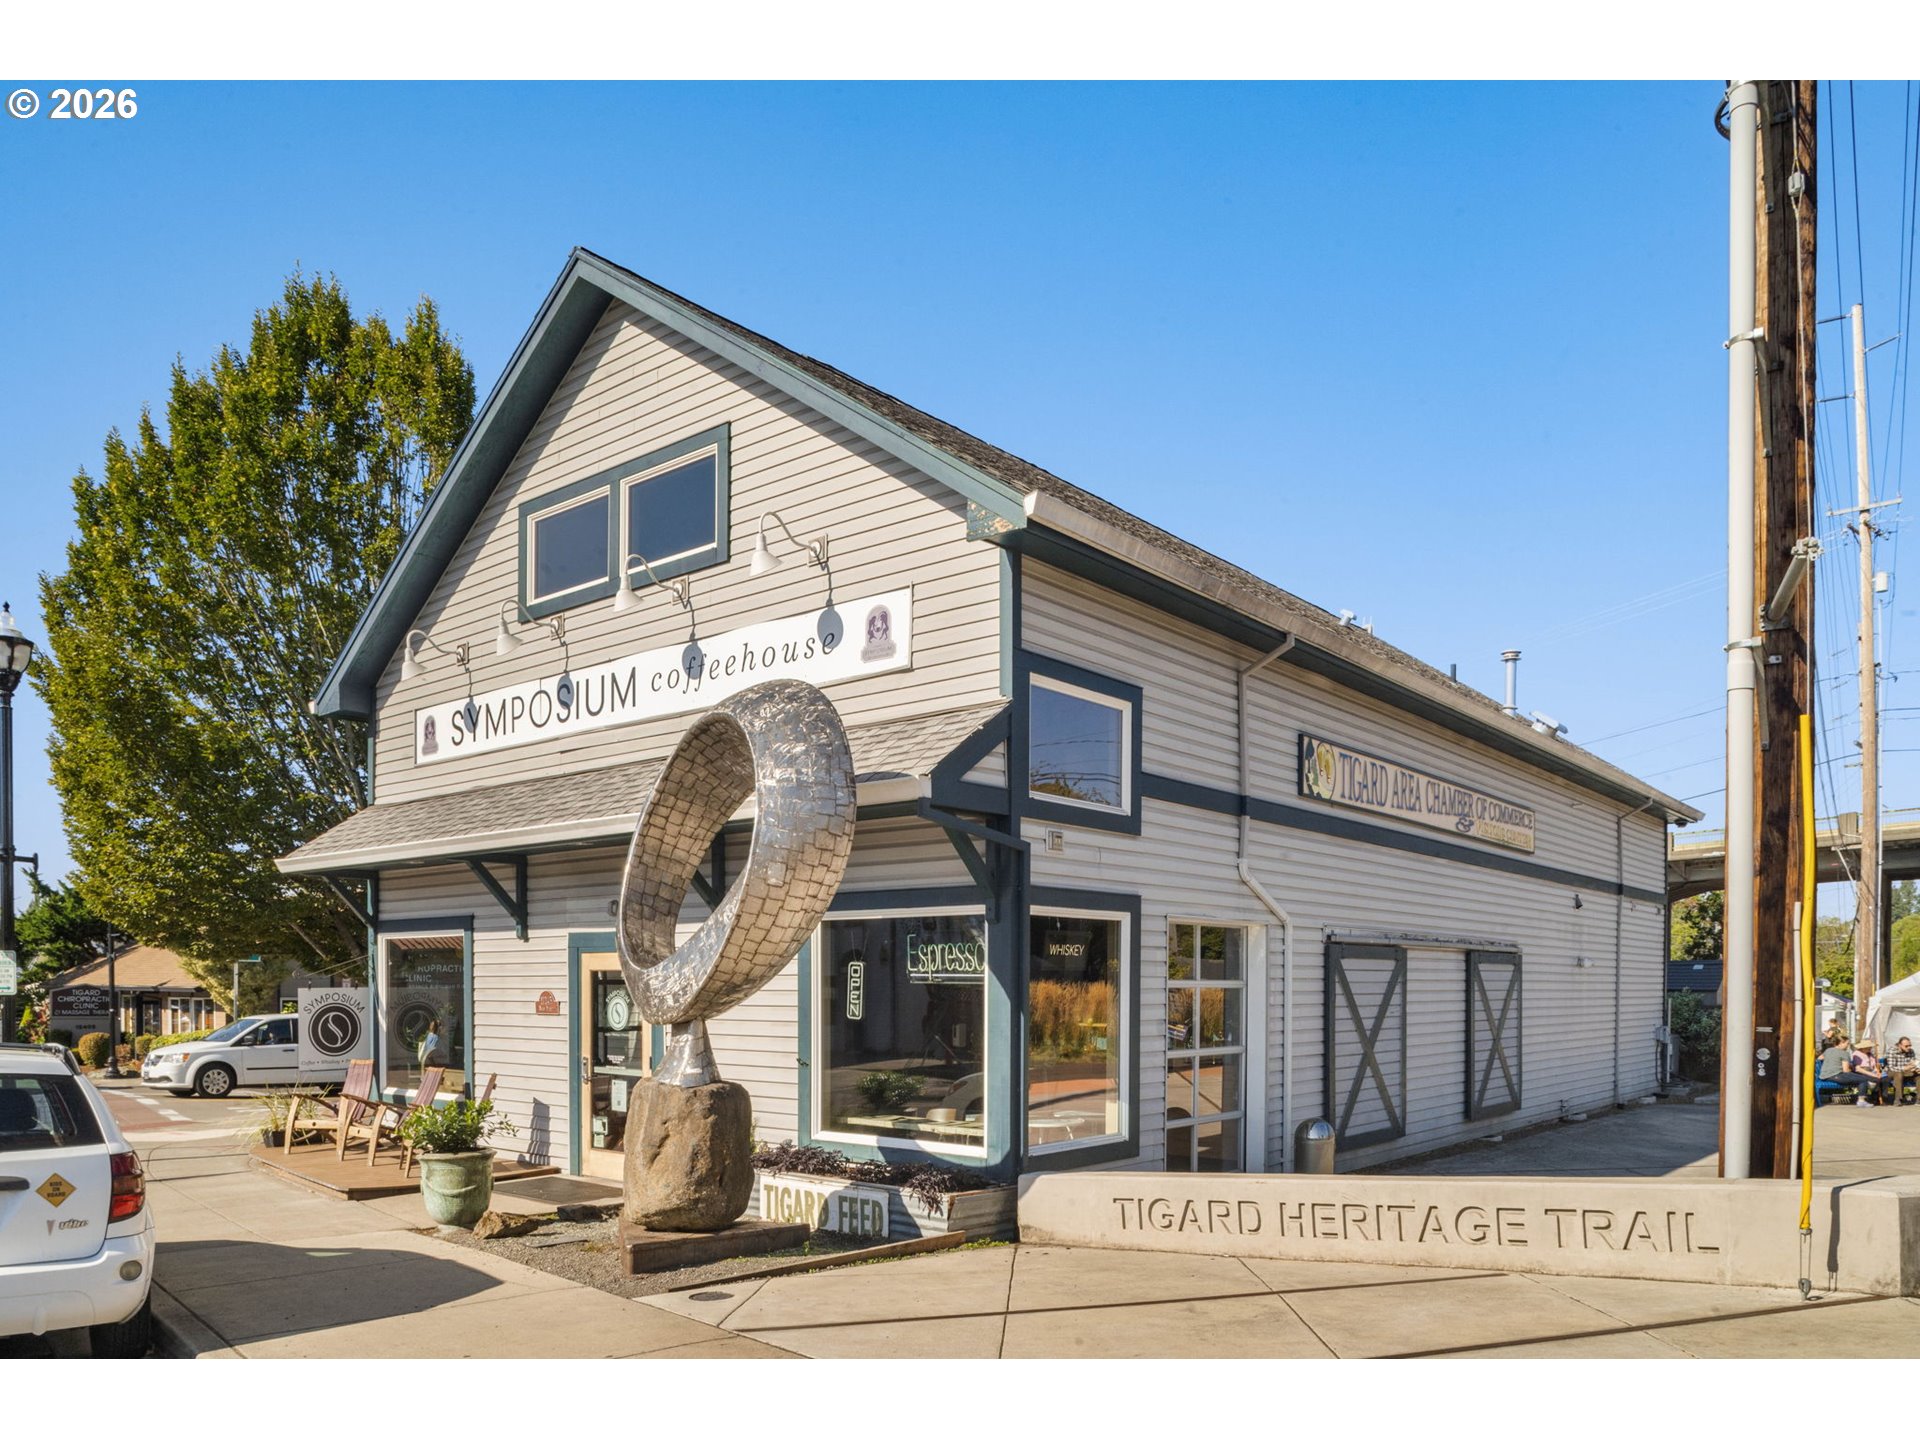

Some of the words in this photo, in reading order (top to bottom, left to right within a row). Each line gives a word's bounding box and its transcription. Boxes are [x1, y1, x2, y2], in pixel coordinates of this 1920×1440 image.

[451, 666, 637, 746] SYMPOSIUM
[651, 631, 836, 693] coffeehouse
[1339, 752, 1389, 807] TIGARD
[1391, 768, 1423, 813] AREA
[1425, 780, 1475, 818] CHAMBER
[1475, 798, 1488, 820] OF
[1488, 801, 1533, 830] COMMERCE
[1455, 816, 1475, 833] &
[907, 934, 986, 982] Espresso
[1050, 944, 1085, 956] WHISKEY
[303, 992, 366, 1014] SYMPOSIUM
[849, 965, 861, 1016] OPEN
[764, 1184, 830, 1229] TIGARD
[838, 1194, 884, 1237] FEED
[1113, 1197, 1262, 1235] TIGARD
[1279, 1201, 1528, 1247] HERITAGE
[1543, 1208, 1720, 1254] TRAIL
